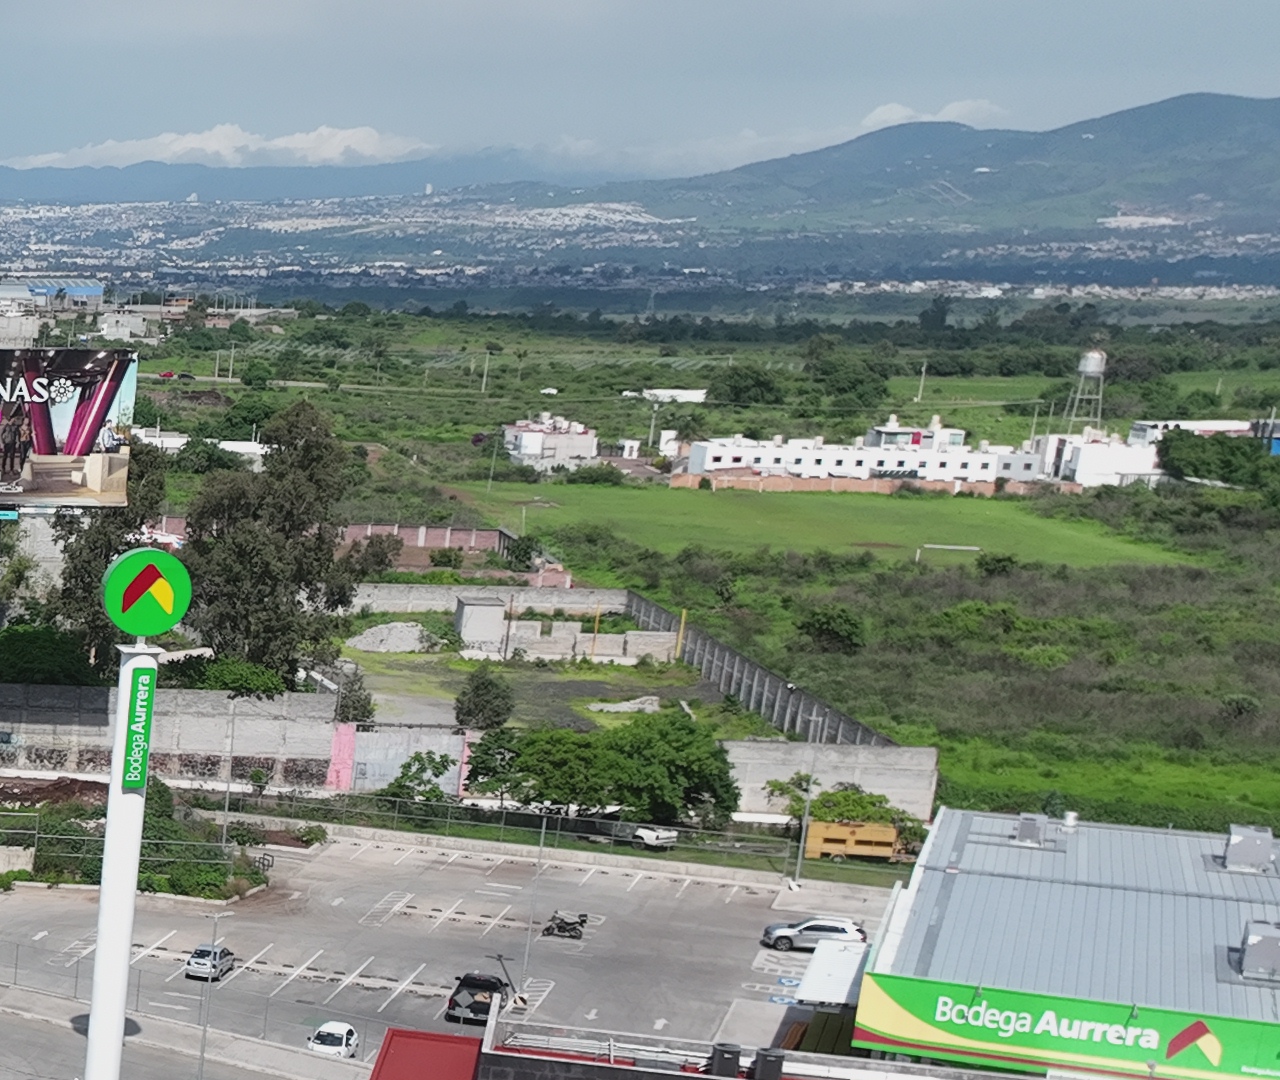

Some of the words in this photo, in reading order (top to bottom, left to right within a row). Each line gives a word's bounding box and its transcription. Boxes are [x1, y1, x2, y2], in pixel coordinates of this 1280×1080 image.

[130, 674, 151, 734] Aurrera
[125, 734, 148, 782] Bodega
[933, 995, 1032, 1038] Bodega
[1032, 1010, 1161, 1050] Aurrera
